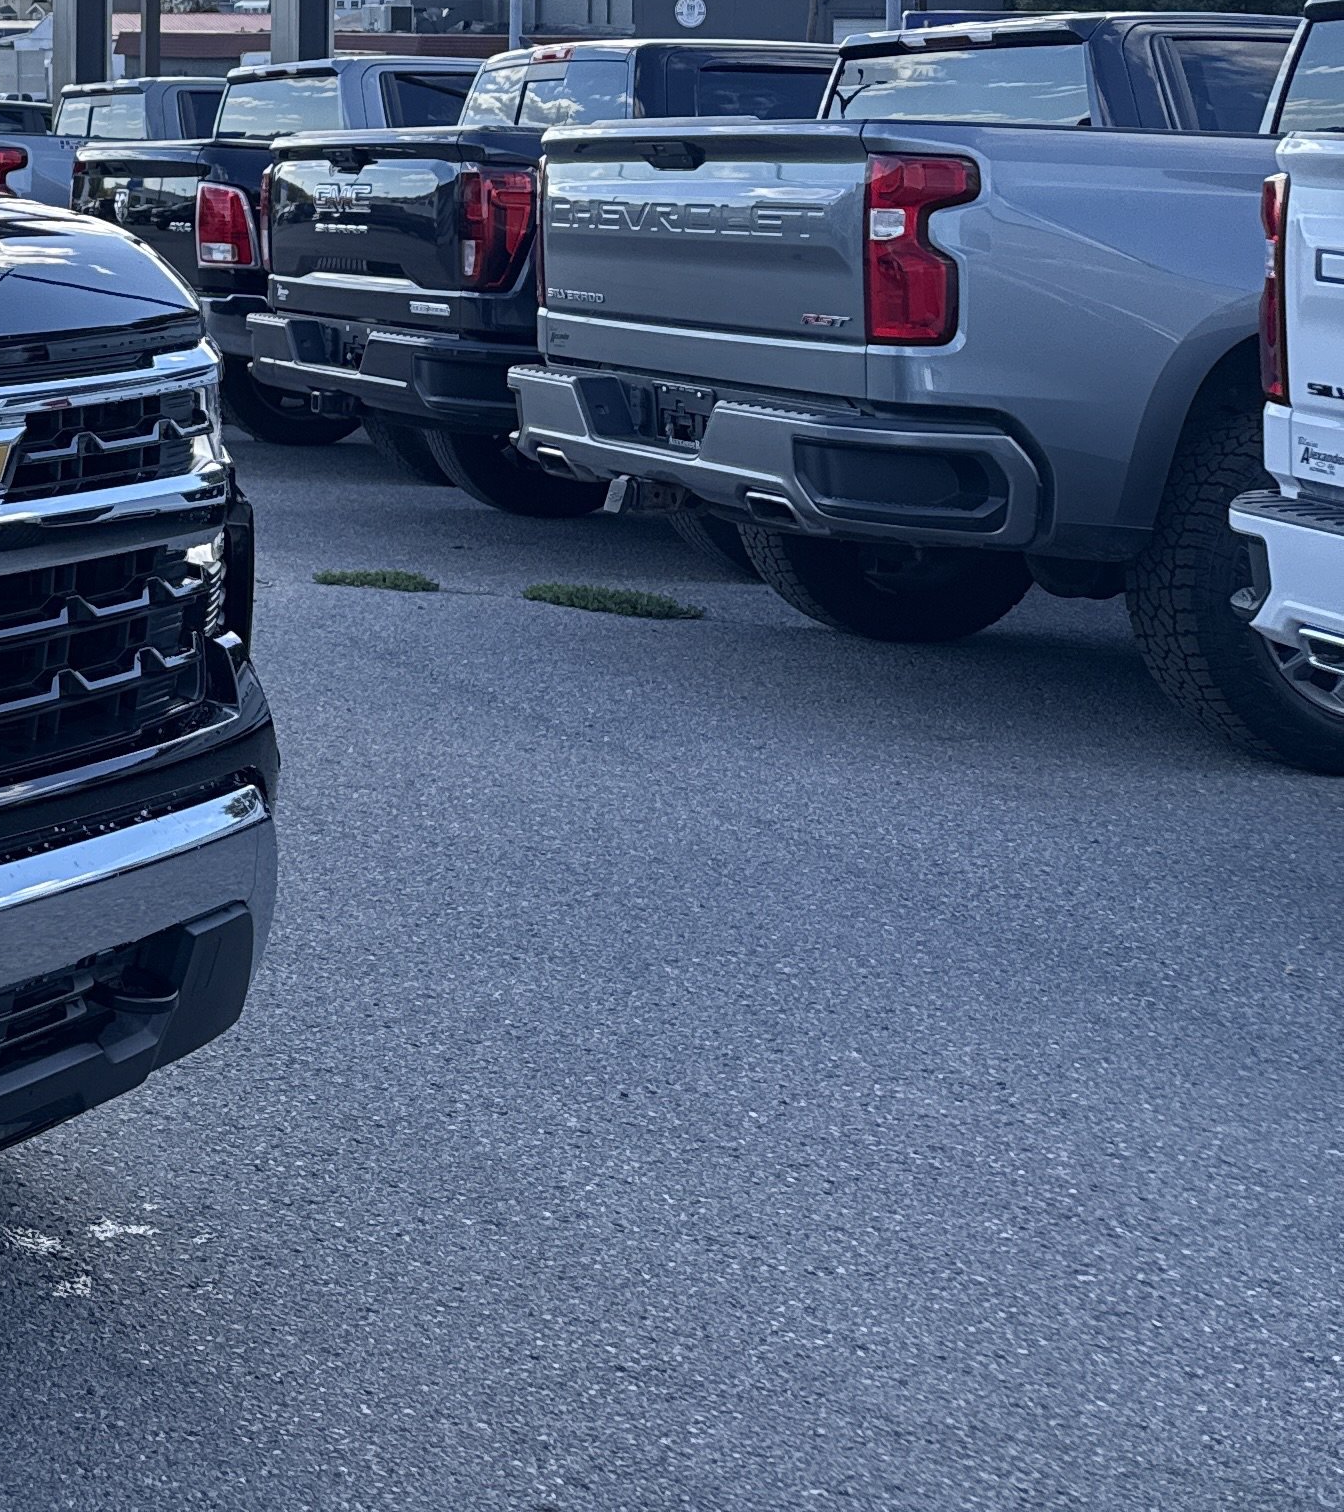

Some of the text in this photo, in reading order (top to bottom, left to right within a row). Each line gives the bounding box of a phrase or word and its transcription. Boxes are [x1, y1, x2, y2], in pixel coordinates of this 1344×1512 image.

[314, 183, 372, 213] GMC
[550, 196, 833, 238] CHEVROLET
[314, 222, 368, 234] SIERRA
[547, 287, 604, 304] SILVERADO
[800, 312, 853, 327] RST
